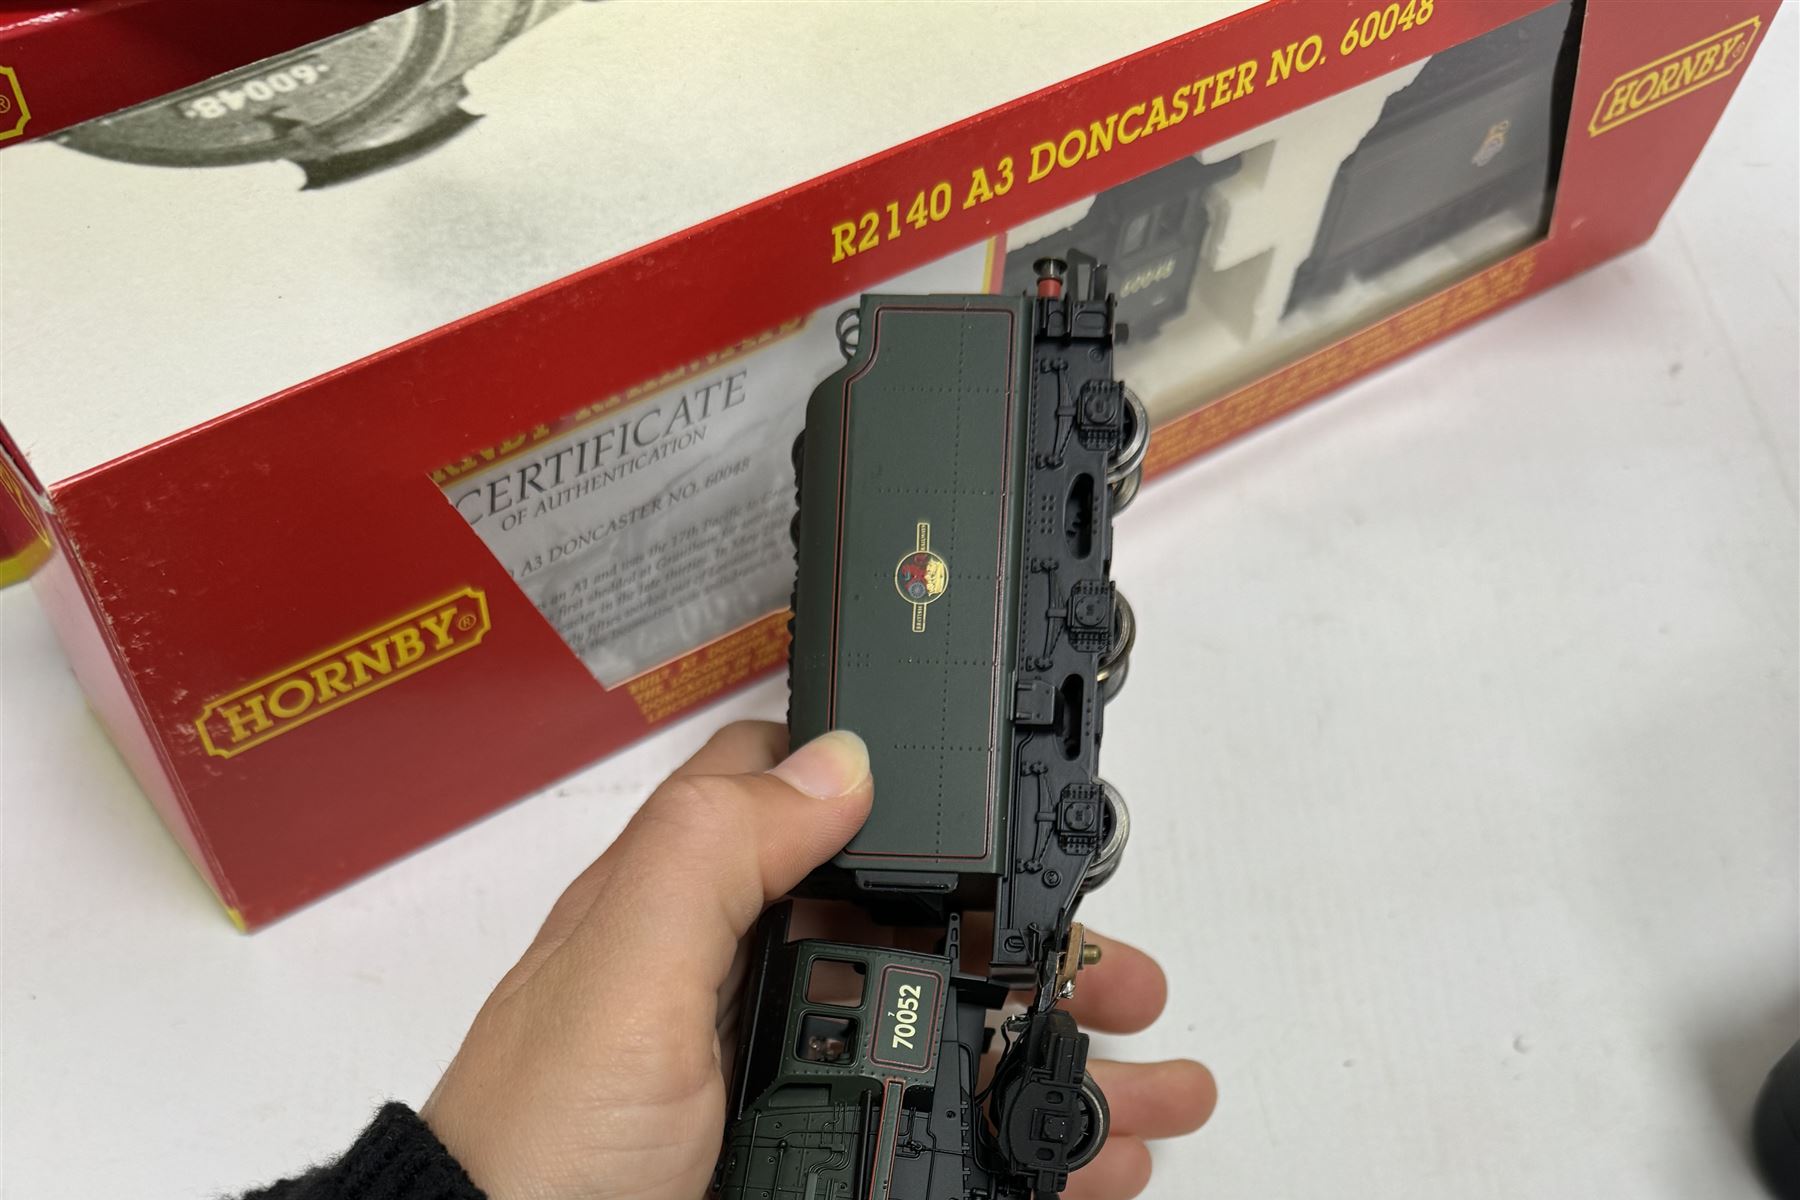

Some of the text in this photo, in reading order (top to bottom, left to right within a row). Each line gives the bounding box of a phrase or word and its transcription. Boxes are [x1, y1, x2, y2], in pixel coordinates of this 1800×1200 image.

[1602, 32, 1744, 123] HORNBY
[831, 0, 1434, 263] R2140 A3 DONCASTER NO. 60048
[455, 369, 748, 526] CERTIFICATE
[501, 508, 530, 532] OF
[533, 425, 708, 519] AUTHENTICATION
[521, 555, 543, 578] A3
[549, 498, 663, 562] DONCASTER
[667, 481, 700, 503] NO.
[222, 606, 458, 744] HORNBY
[892, 984, 921, 1050] 70052
